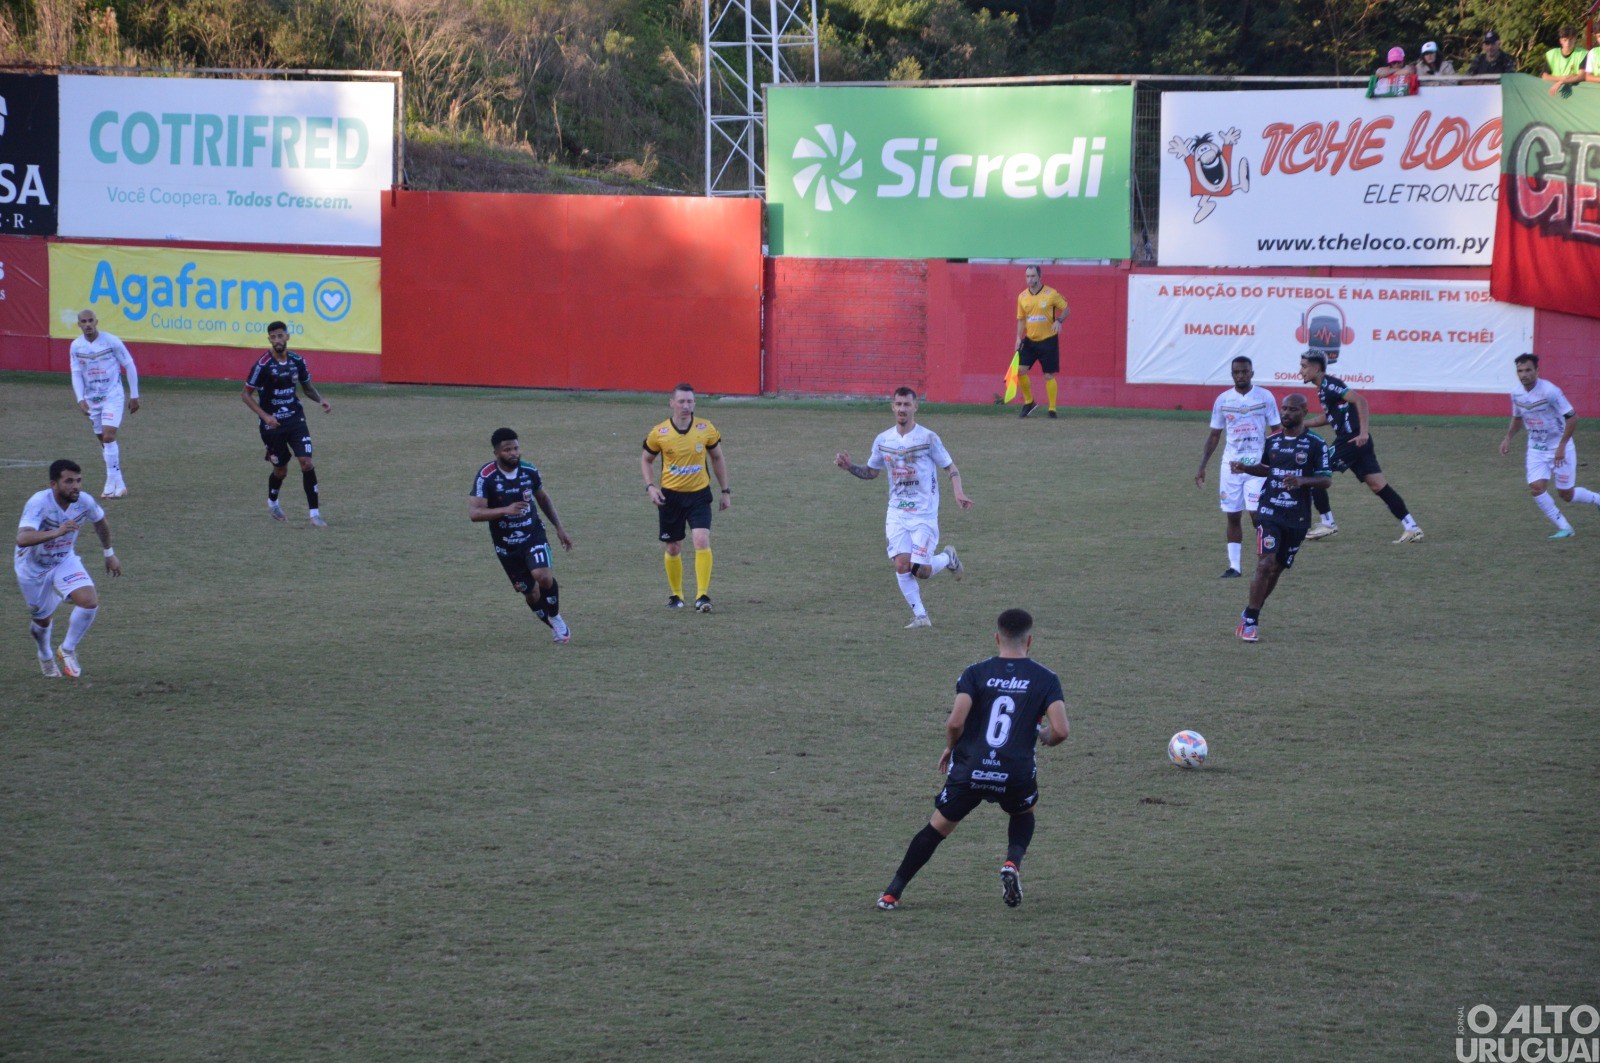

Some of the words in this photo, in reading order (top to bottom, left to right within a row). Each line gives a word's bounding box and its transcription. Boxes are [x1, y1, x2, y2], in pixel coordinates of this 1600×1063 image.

[89, 110, 369, 170] COTRIFRED
[1260, 115, 1395, 177] TCHE
[876, 136, 1107, 199] Sicredi
[107, 187, 146, 204] Você
[150, 187, 222, 207] Coopera.
[226, 190, 272, 207] Todos
[276, 192, 353, 210] Crescem.
[1257, 233, 1490, 254] www.tcheloco.com.py
[89, 260, 305, 321] Agafarma
[1158, 286, 1169, 296] A
[1173, 283, 1237, 300] EMOÇÃO
[1241, 287, 1263, 297] DO
[1267, 286, 1334, 299] FUTEBOL
[1338, 286, 1347, 299] É
[1352, 288, 1374, 299] NA
[1378, 289, 1433, 301] BARRIL
[1438, 290, 1460, 302] FM
[151, 313, 193, 330] Cuida
[197, 319, 227, 332] com
[231, 321, 240, 332] o
[245, 320, 304, 335] corão
[1184, 323, 1255, 336] IMAGINA!
[1372, 329, 1382, 341] E
[1386, 330, 1443, 342] AGORA
[1447, 328, 1494, 343] TCHÊ!
[1274, 372, 1306, 381] SOMO
[1341, 372, 1375, 383] UNIÃO!
[533, 551, 545, 564] 11
[986, 676, 1031, 689] creluz
[986, 695, 1016, 748] 6
